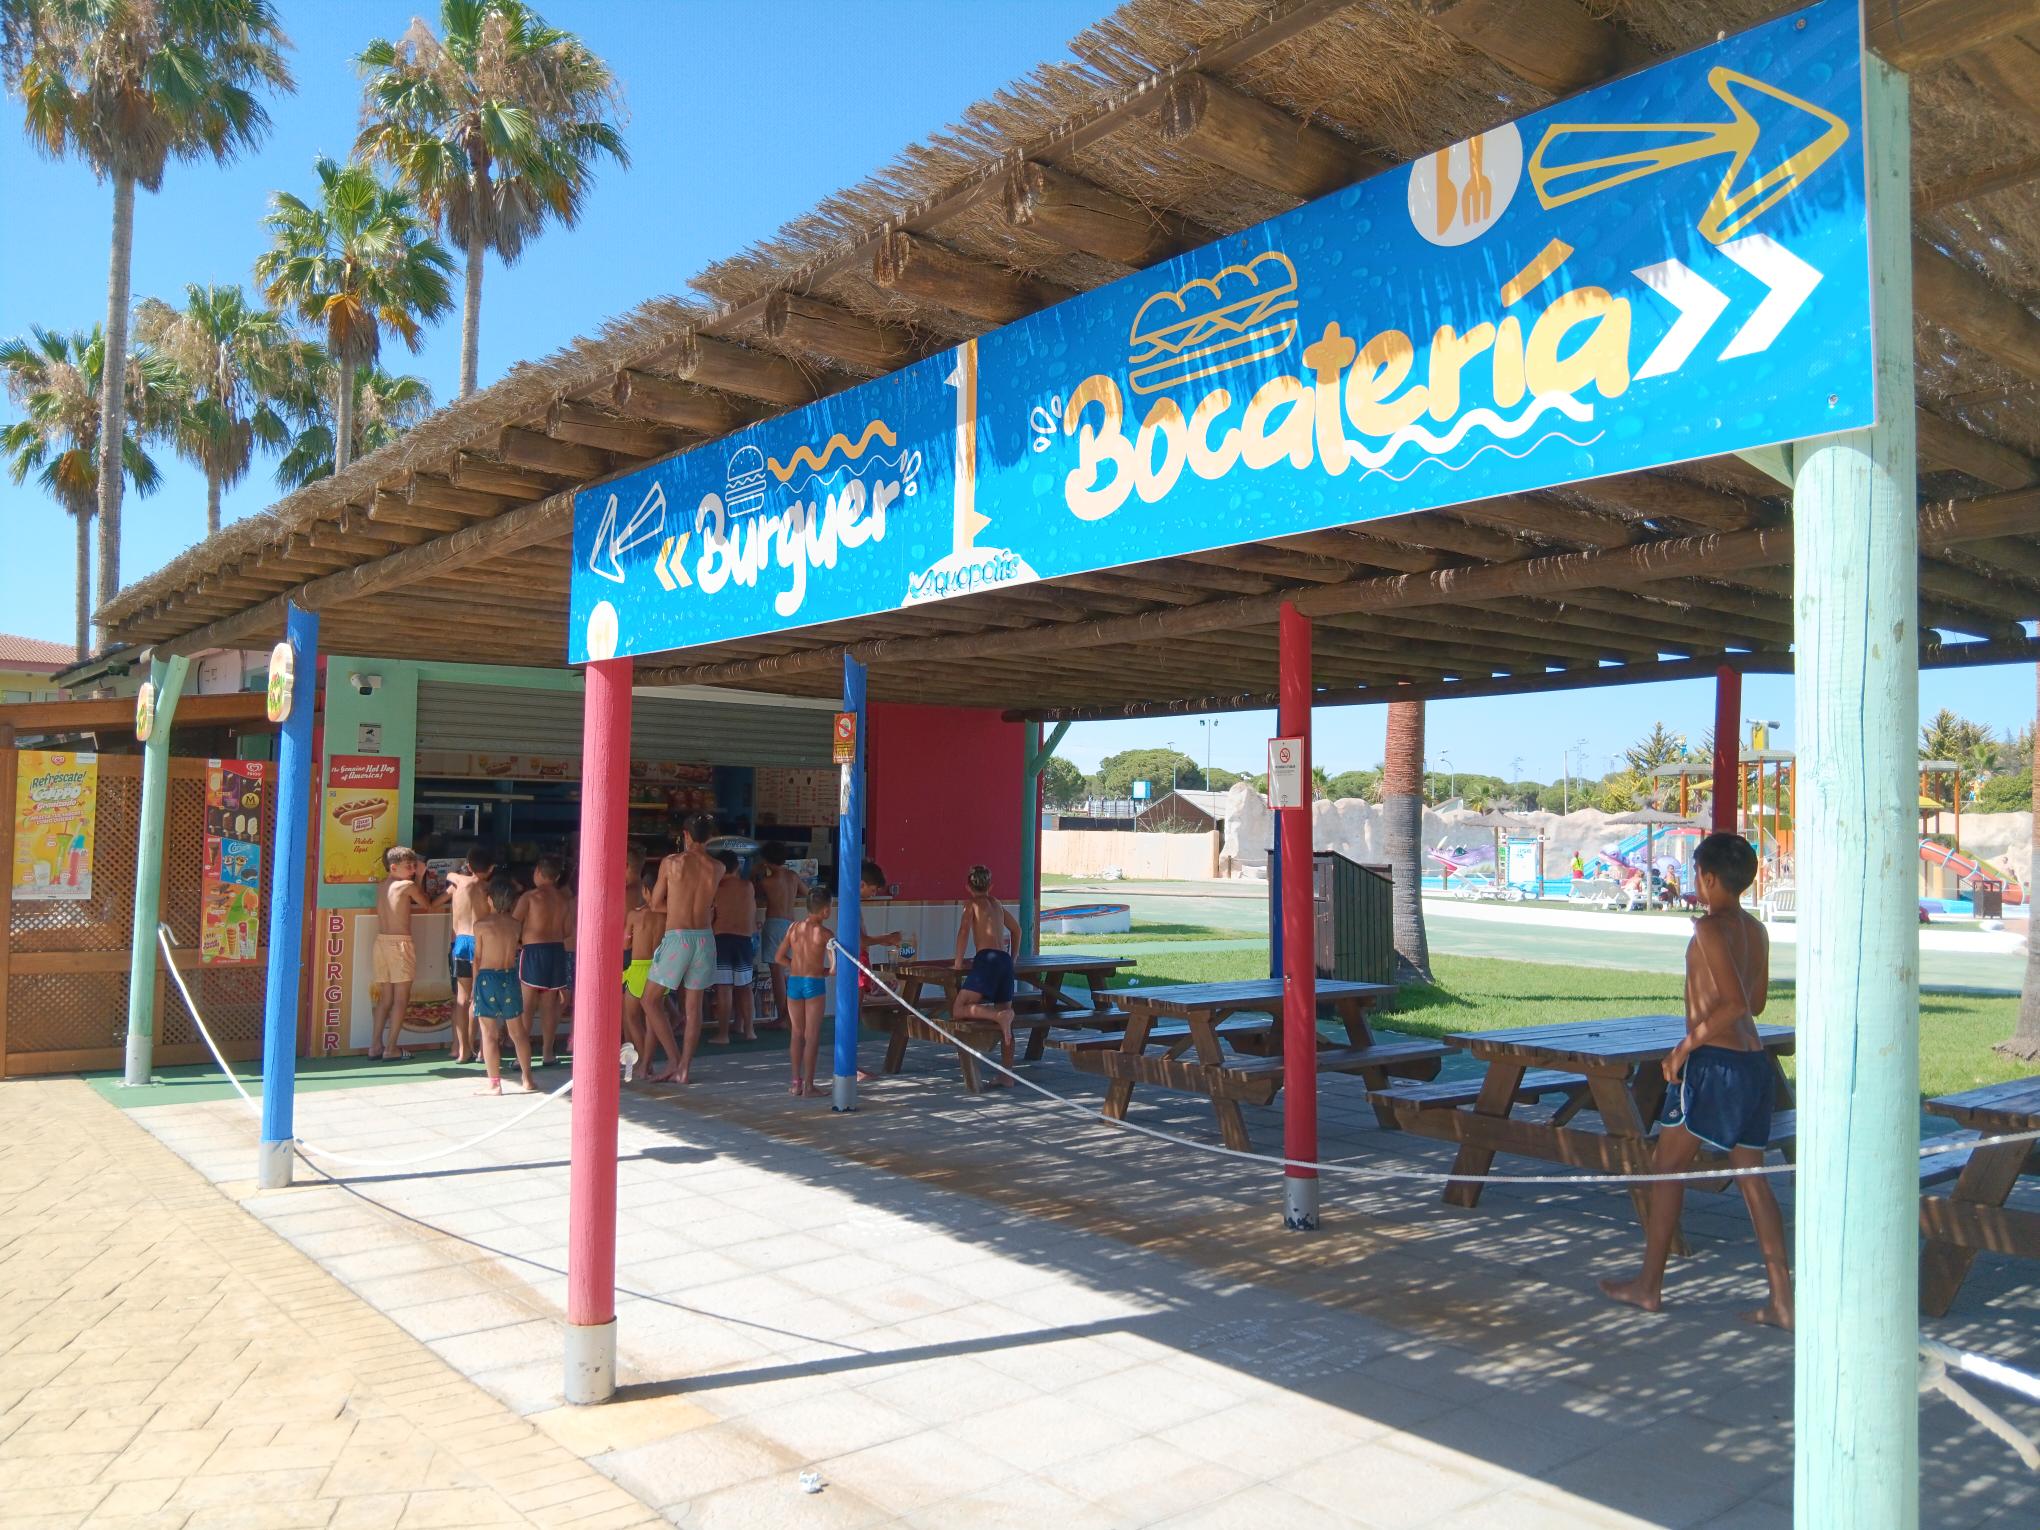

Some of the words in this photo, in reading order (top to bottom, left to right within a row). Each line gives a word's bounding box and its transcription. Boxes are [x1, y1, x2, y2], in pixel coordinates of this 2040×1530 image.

[1063, 238, 1632, 521] Bocatería
[695, 479, 901, 617] Burguer
[365, 764, 380, 773] Hot
[380, 764, 395, 773] Dog
[323, 915, 345, 1050] BURGER
